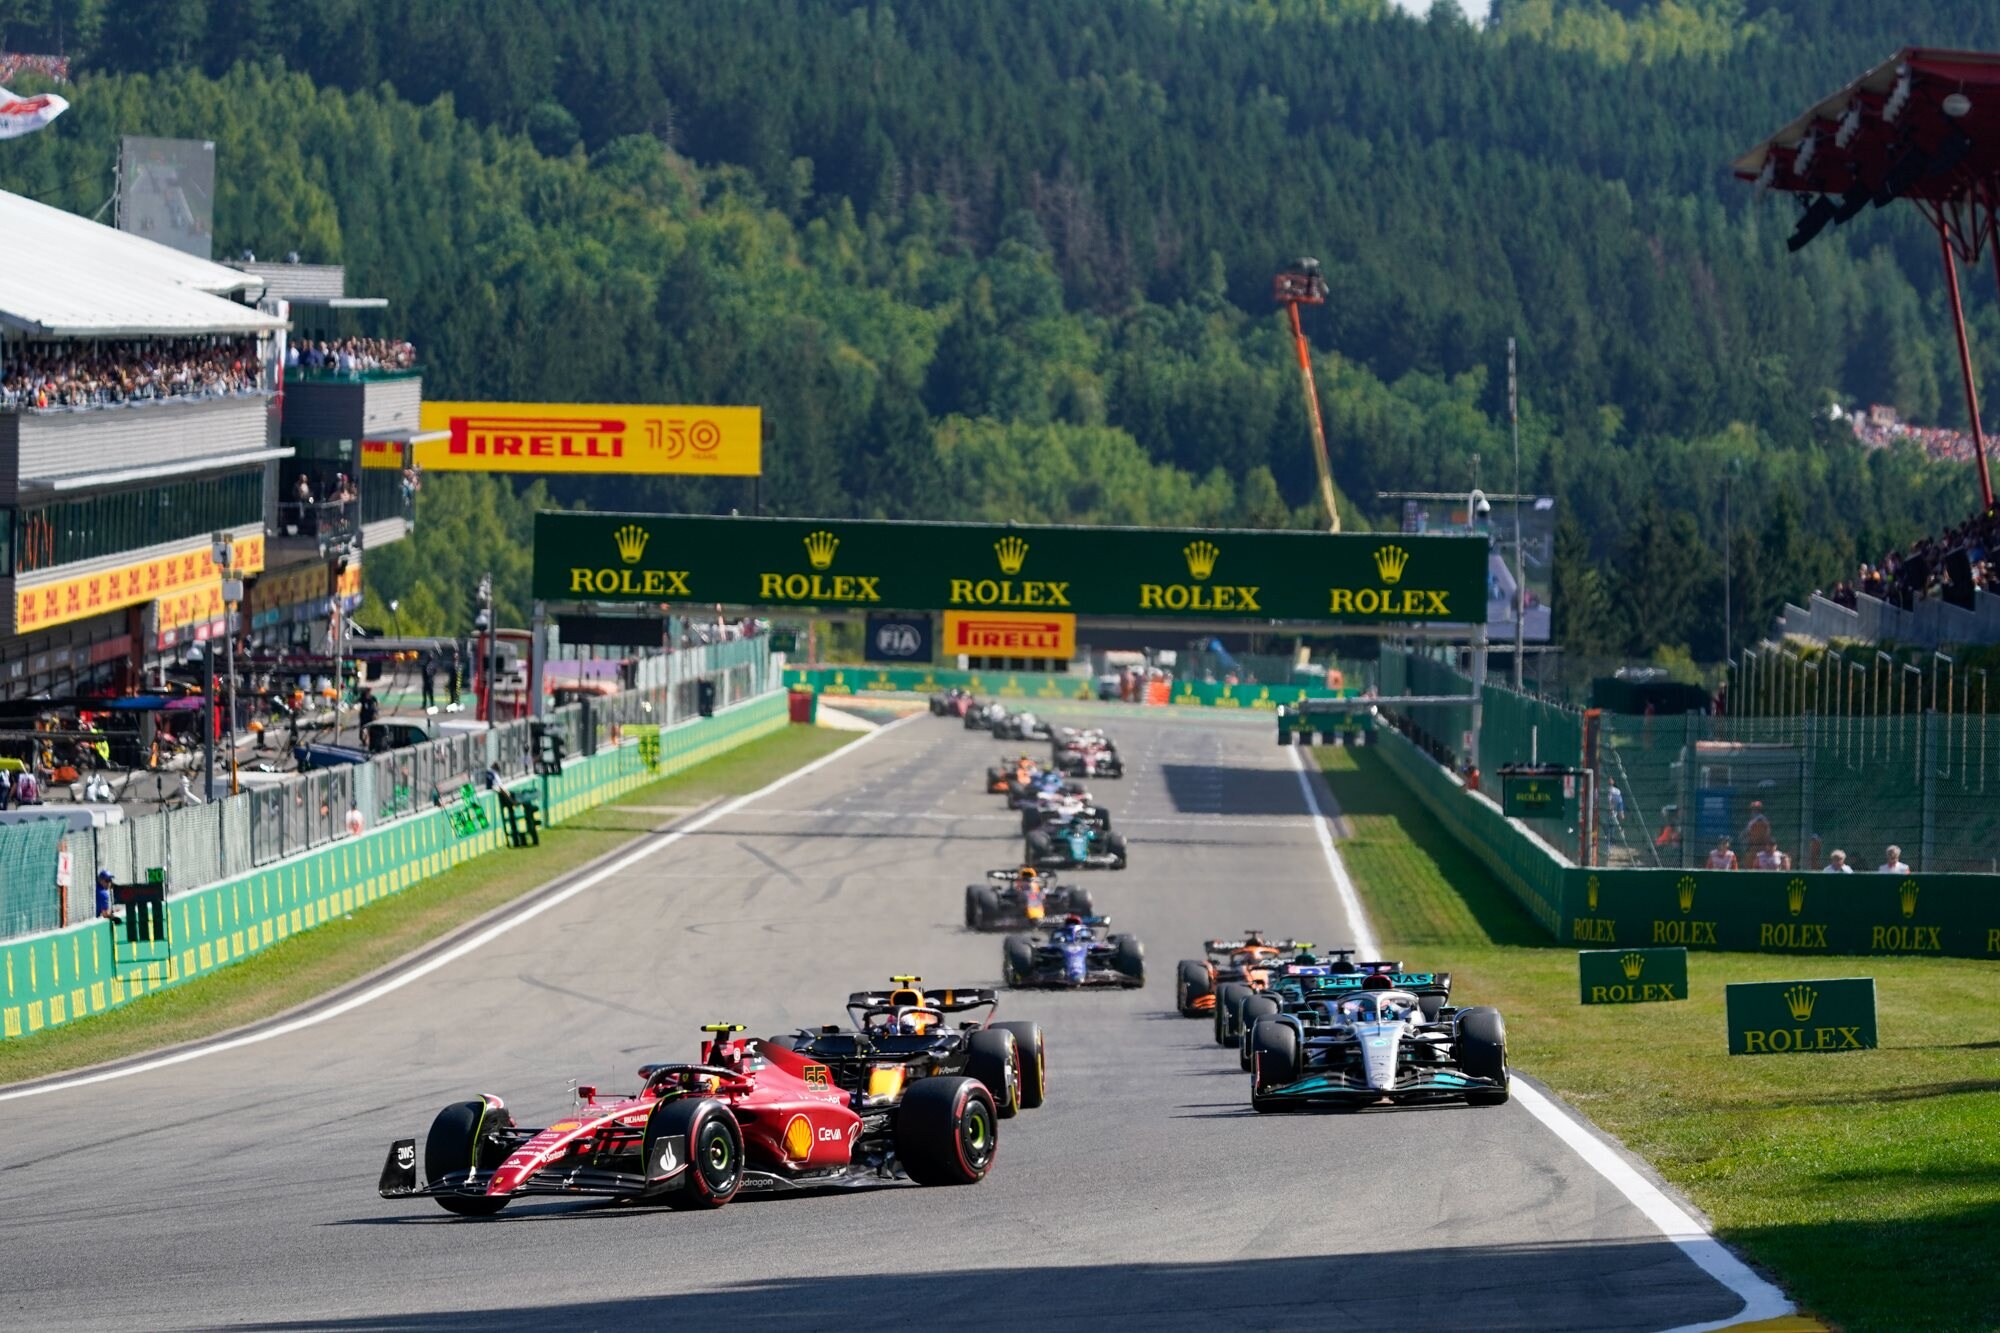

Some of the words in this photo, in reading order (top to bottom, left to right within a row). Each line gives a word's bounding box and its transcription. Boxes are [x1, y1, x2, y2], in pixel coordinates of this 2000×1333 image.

[448, 416, 627, 459] PIRELLI
[644, 418, 721, 459] 150
[570, 567, 691, 596] ROLEX
[759, 572, 881, 602] ROLEX
[950, 578, 1071, 607] ROLEX
[1140, 583, 1261, 612] ROLEX
[1330, 587, 1451, 616] ROLEX
[956, 620, 1061, 649] PIRELLI
[1573, 917, 1615, 942] ROLEX
[1652, 919, 1717, 945] ROLEX
[1760, 922, 1828, 948] ROLEX
[1871, 925, 1941, 950] ROLEX
[1324, 974, 1428, 987] PETNAS
[1591, 983, 1677, 1003] ROLEX
[1743, 1026, 1863, 1053] ROLEX
[803, 1064, 830, 1092] 55
[623, 1113, 649, 1125] RICHARD
[739, 1177, 774, 1189] pdragon
